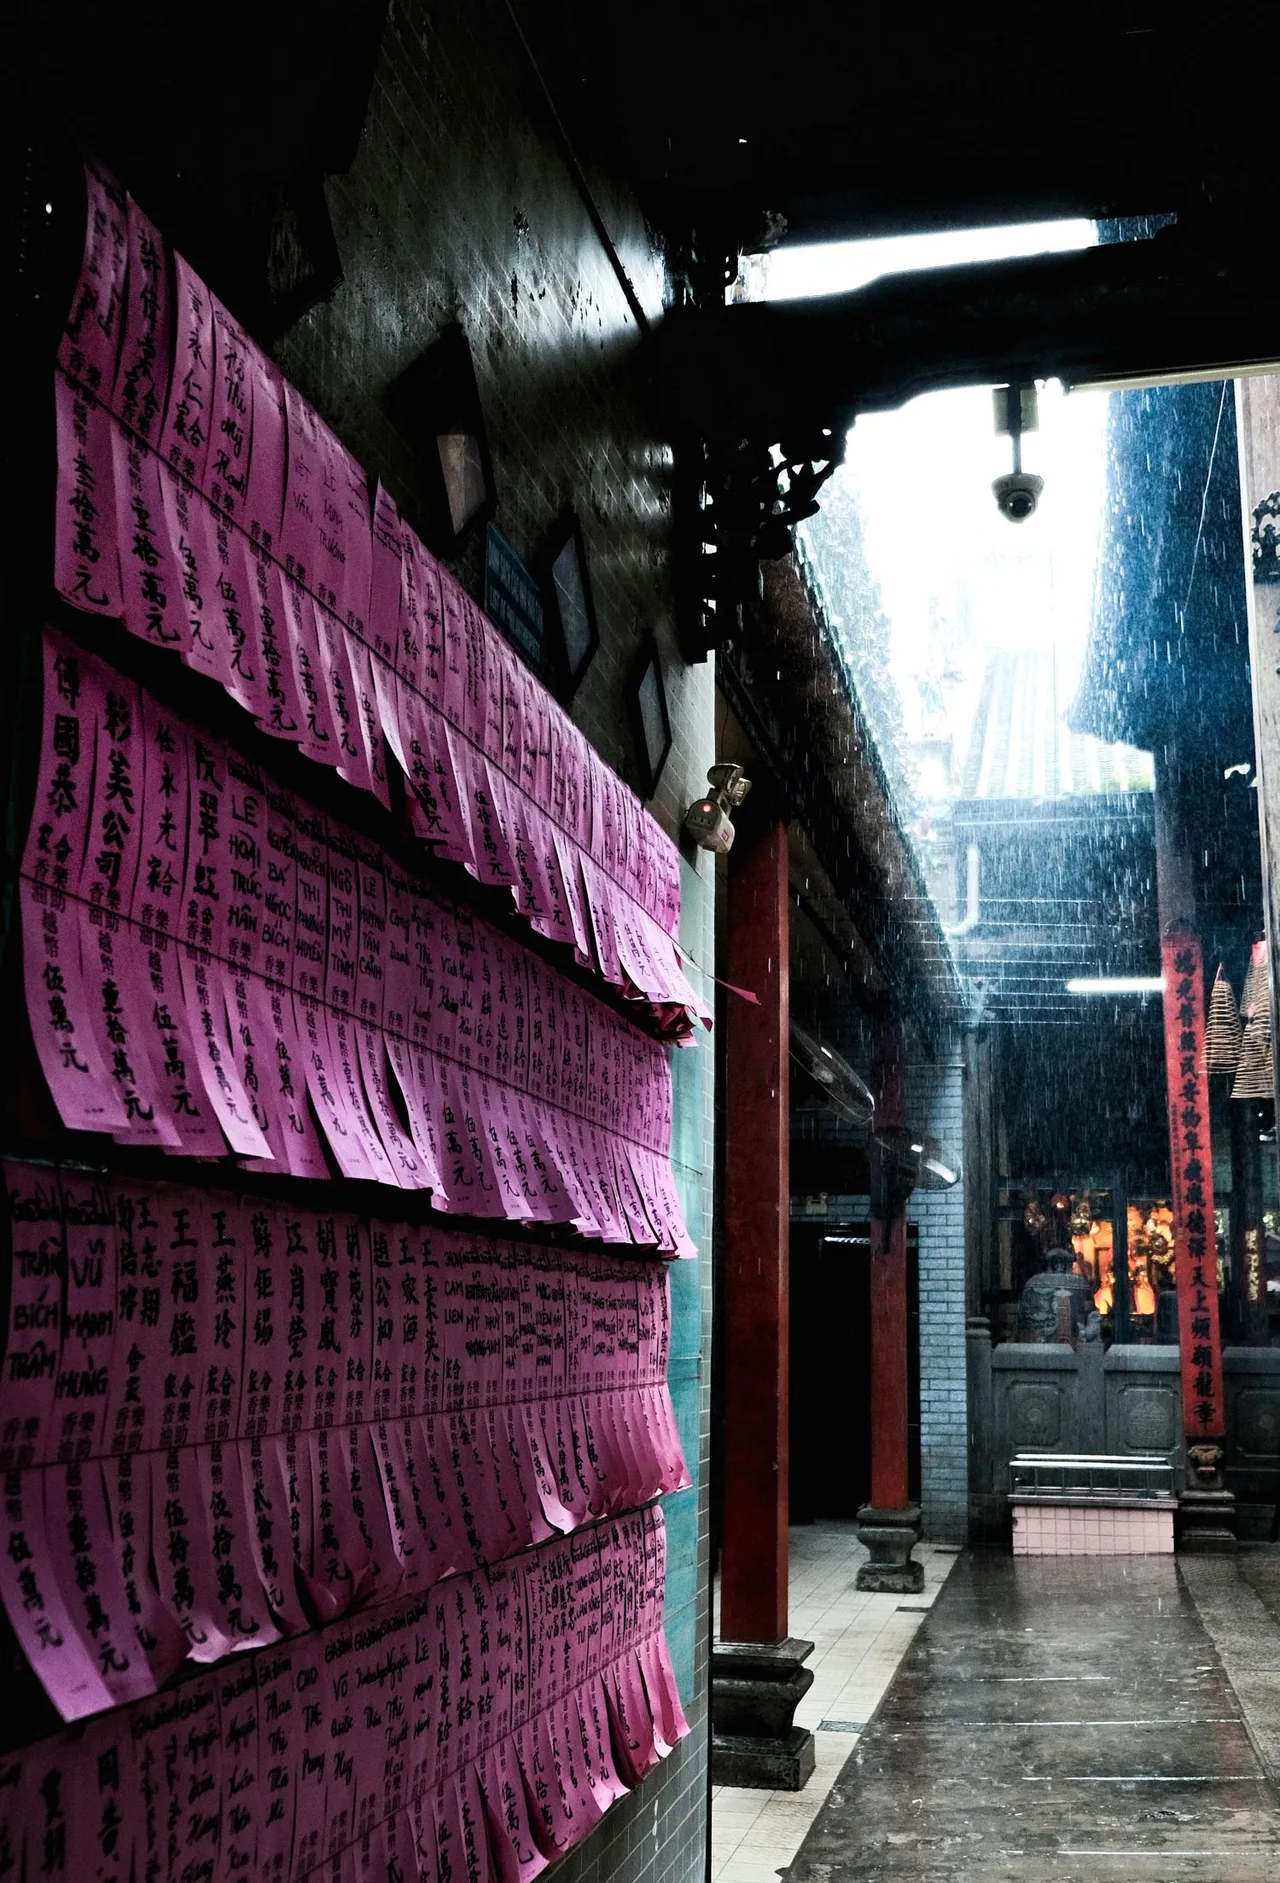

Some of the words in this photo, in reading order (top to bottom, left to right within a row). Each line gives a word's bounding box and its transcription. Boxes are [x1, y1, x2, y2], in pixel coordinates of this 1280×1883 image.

[43, 962, 88, 1073] 伍萬元
[102, 978, 153, 1120] 壹拾萬元
[153, 1001, 199, 1117] 伍萬元
[443, 1101, 473, 1186] 伍萬元
[465, 1111, 493, 1191] 伍萬元
[489, 1120, 519, 1197] 伍萬元
[507, 1124, 537, 1197] 伍萬元
[525, 1129, 557, 1193] 伍萬元
[210, 1489, 259, 1637] 伍拾萬元
[320, 1469, 353, 1582] 壹拾萬元
[68, 1512, 129, 1675] 壹拾萬元
